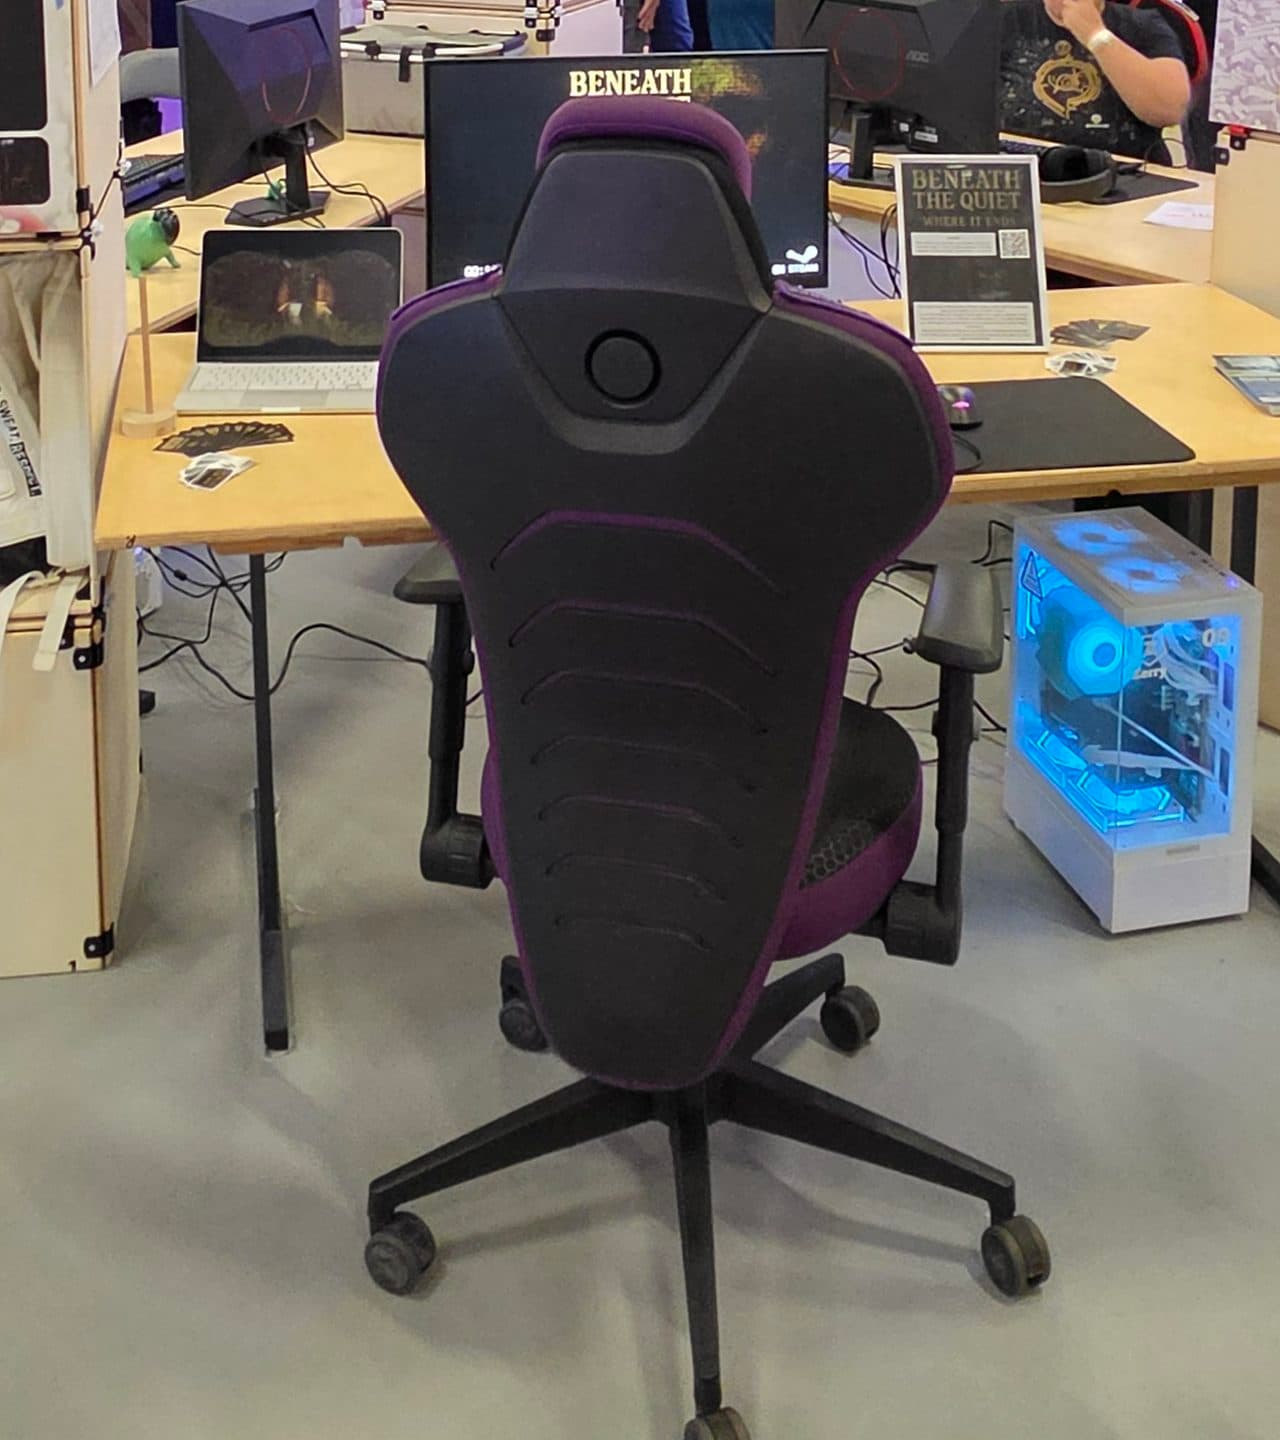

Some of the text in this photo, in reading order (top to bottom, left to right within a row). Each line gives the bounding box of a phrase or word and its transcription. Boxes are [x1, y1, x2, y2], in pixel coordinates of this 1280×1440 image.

[568, 68, 692, 98] BENEATH
[911, 168, 1020, 190] BENEATH
[911, 190, 1020, 212] THE QUIET
[923, 215, 967, 227] WHERE
